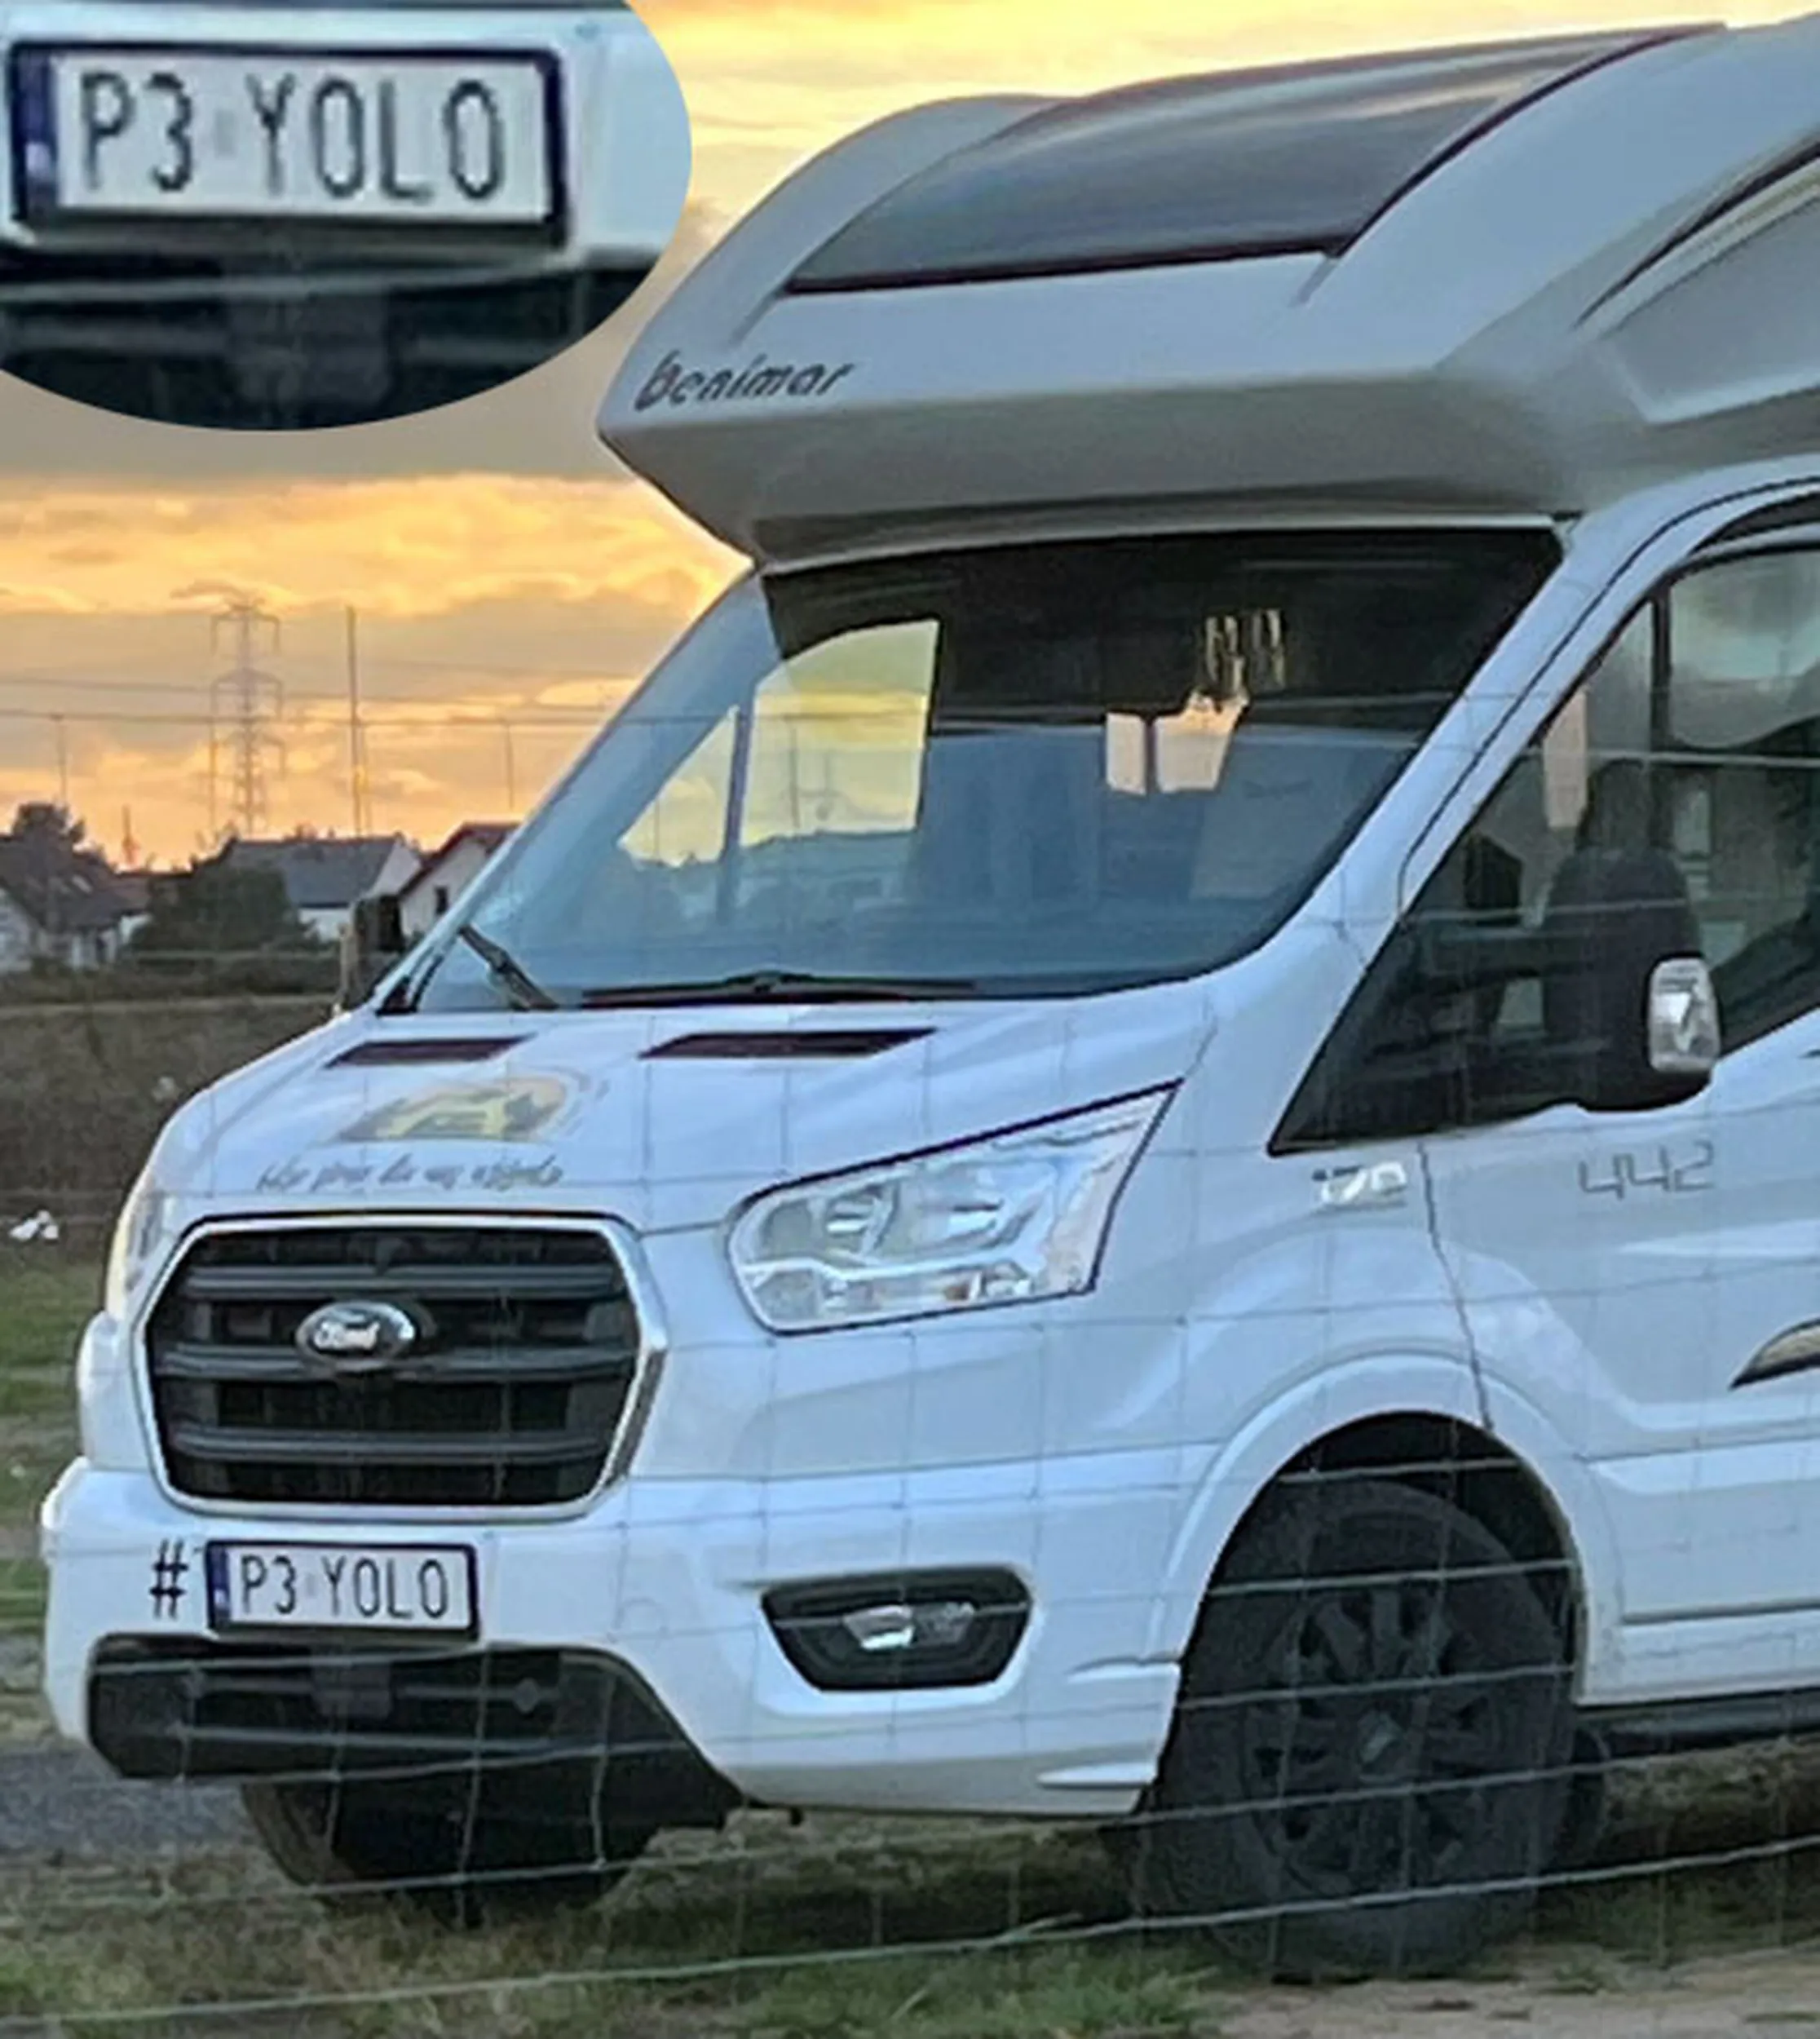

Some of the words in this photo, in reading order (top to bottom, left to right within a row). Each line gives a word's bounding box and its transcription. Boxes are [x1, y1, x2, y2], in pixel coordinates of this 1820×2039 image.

[80, 72, 192, 192] P3
[246, 72, 504, 201] YOLO
[634, 349, 855, 412] benimar
[1579, 1141, 1715, 1200] 442
[241, 1555, 298, 1615] P3
[321, 1555, 448, 1620] YOLO
